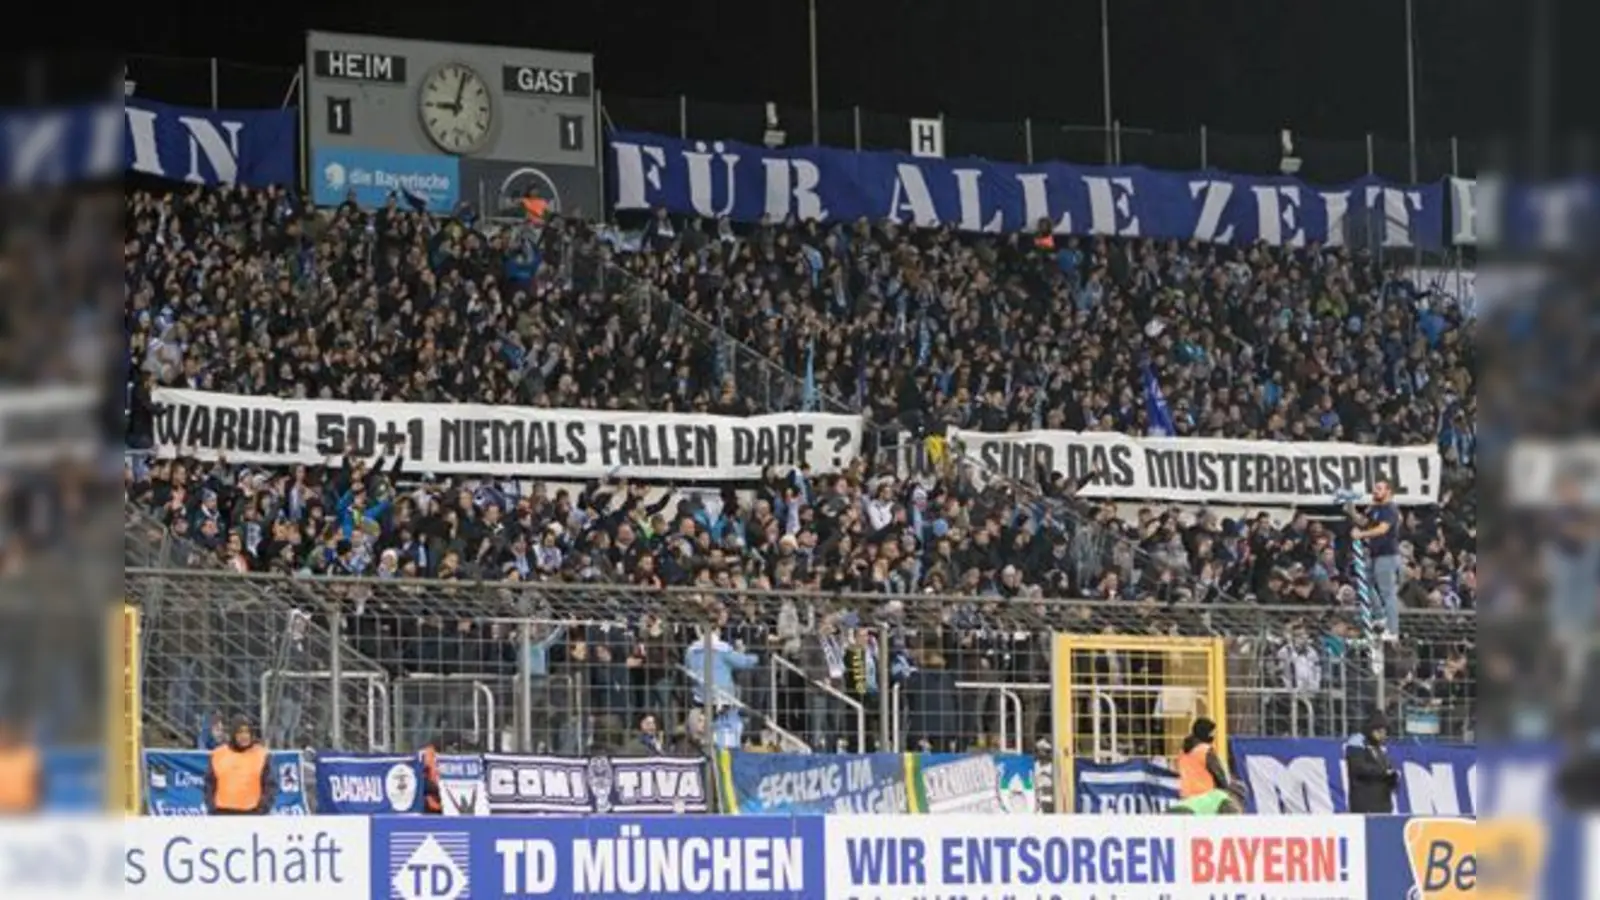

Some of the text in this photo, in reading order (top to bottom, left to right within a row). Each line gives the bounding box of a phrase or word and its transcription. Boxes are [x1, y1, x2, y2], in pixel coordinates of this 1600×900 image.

[328, 53, 393, 80] HEIM
[516, 66, 577, 94] GAST
[333, 104, 344, 129] 1
[566, 122, 576, 146] 1
[919, 124, 936, 152] H
[611, 140, 828, 223] FÜR
[889, 162, 1140, 235] ALLE
[152, 400, 300, 453] WARUM
[316, 413, 424, 461] 50+1
[440, 417, 587, 464] NIEMALS
[599, 422, 718, 468] FALLEN
[732, 424, 814, 466] DARF
[1067, 443, 1134, 487] DAS
[1145, 447, 1408, 495] MUSTERBEISPIEL
[846, 757, 874, 792] IM
[163, 832, 343, 885] Gschäft
[496, 825, 804, 894] TD MÜNCHEN
[846, 836, 1348, 885] WIR ENTSORGEN BAYERN!
[407, 864, 453, 897] TD
